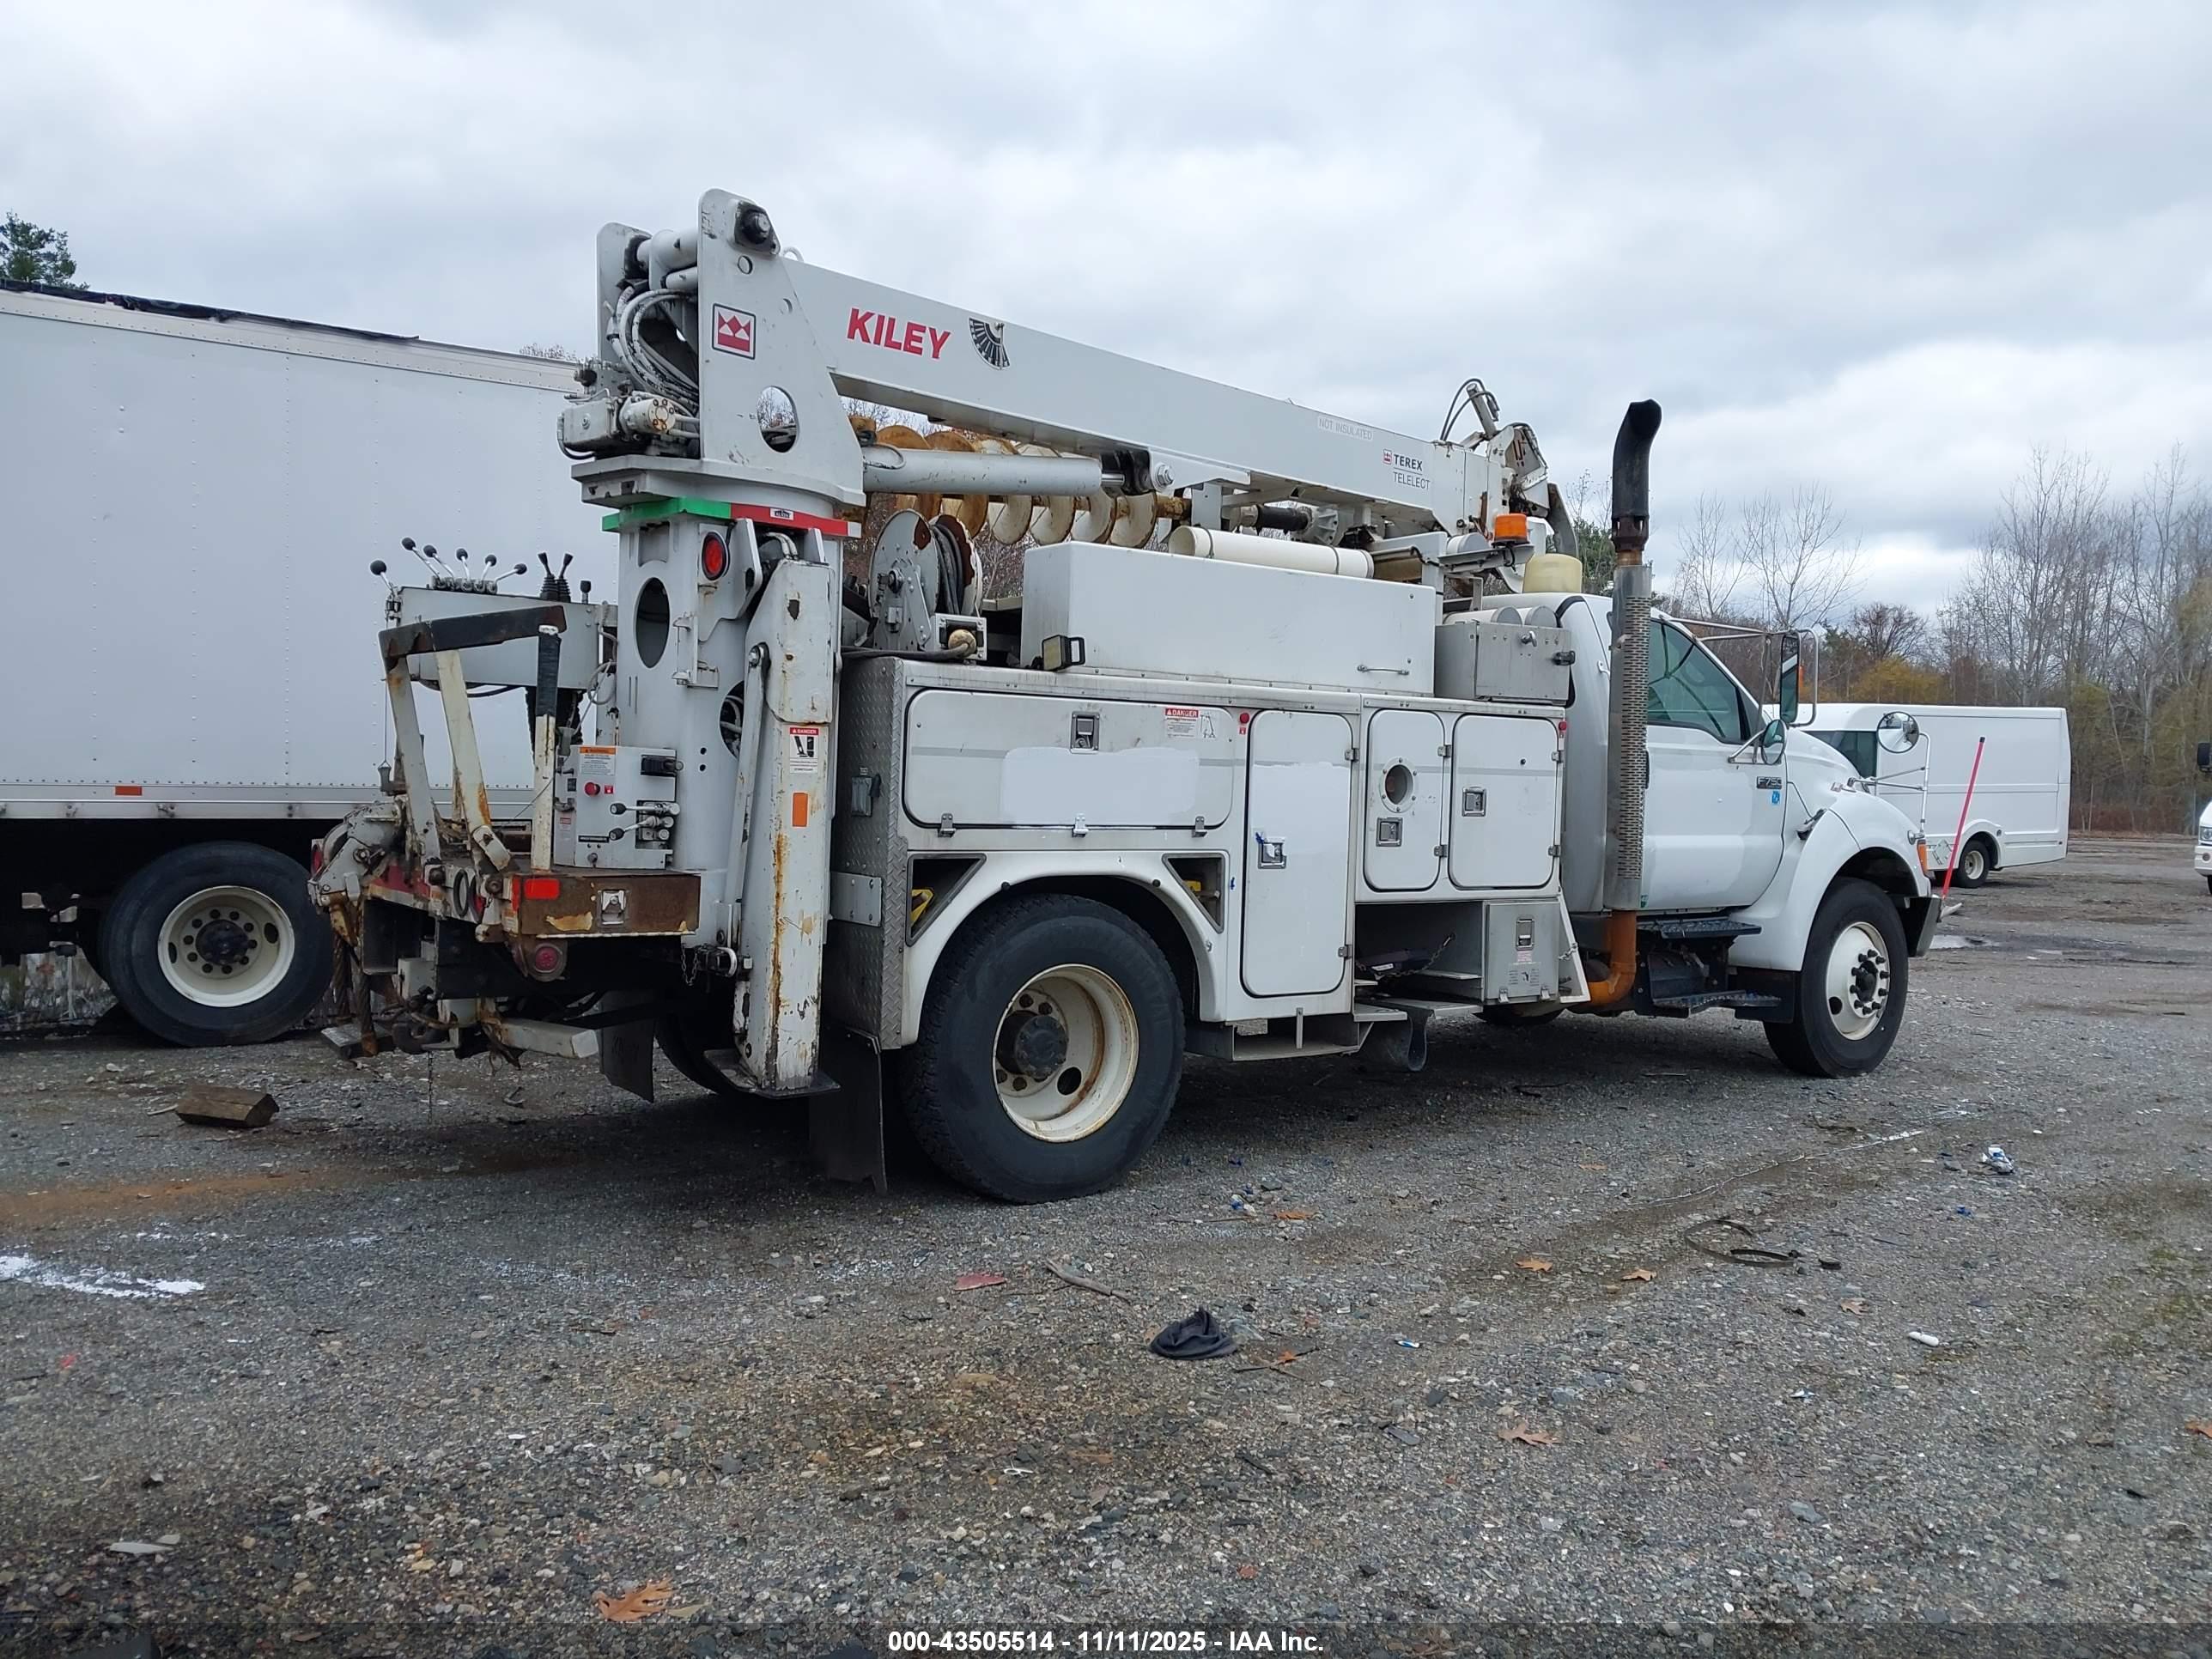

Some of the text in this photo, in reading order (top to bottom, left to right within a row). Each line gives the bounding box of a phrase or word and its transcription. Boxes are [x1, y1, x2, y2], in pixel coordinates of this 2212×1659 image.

[847, 307, 951, 360] KILEY
[1319, 418, 1372, 440] NOT INSULATED
[1394, 453, 1423, 471] TEREX
[1393, 471, 1431, 490] TELELECT
